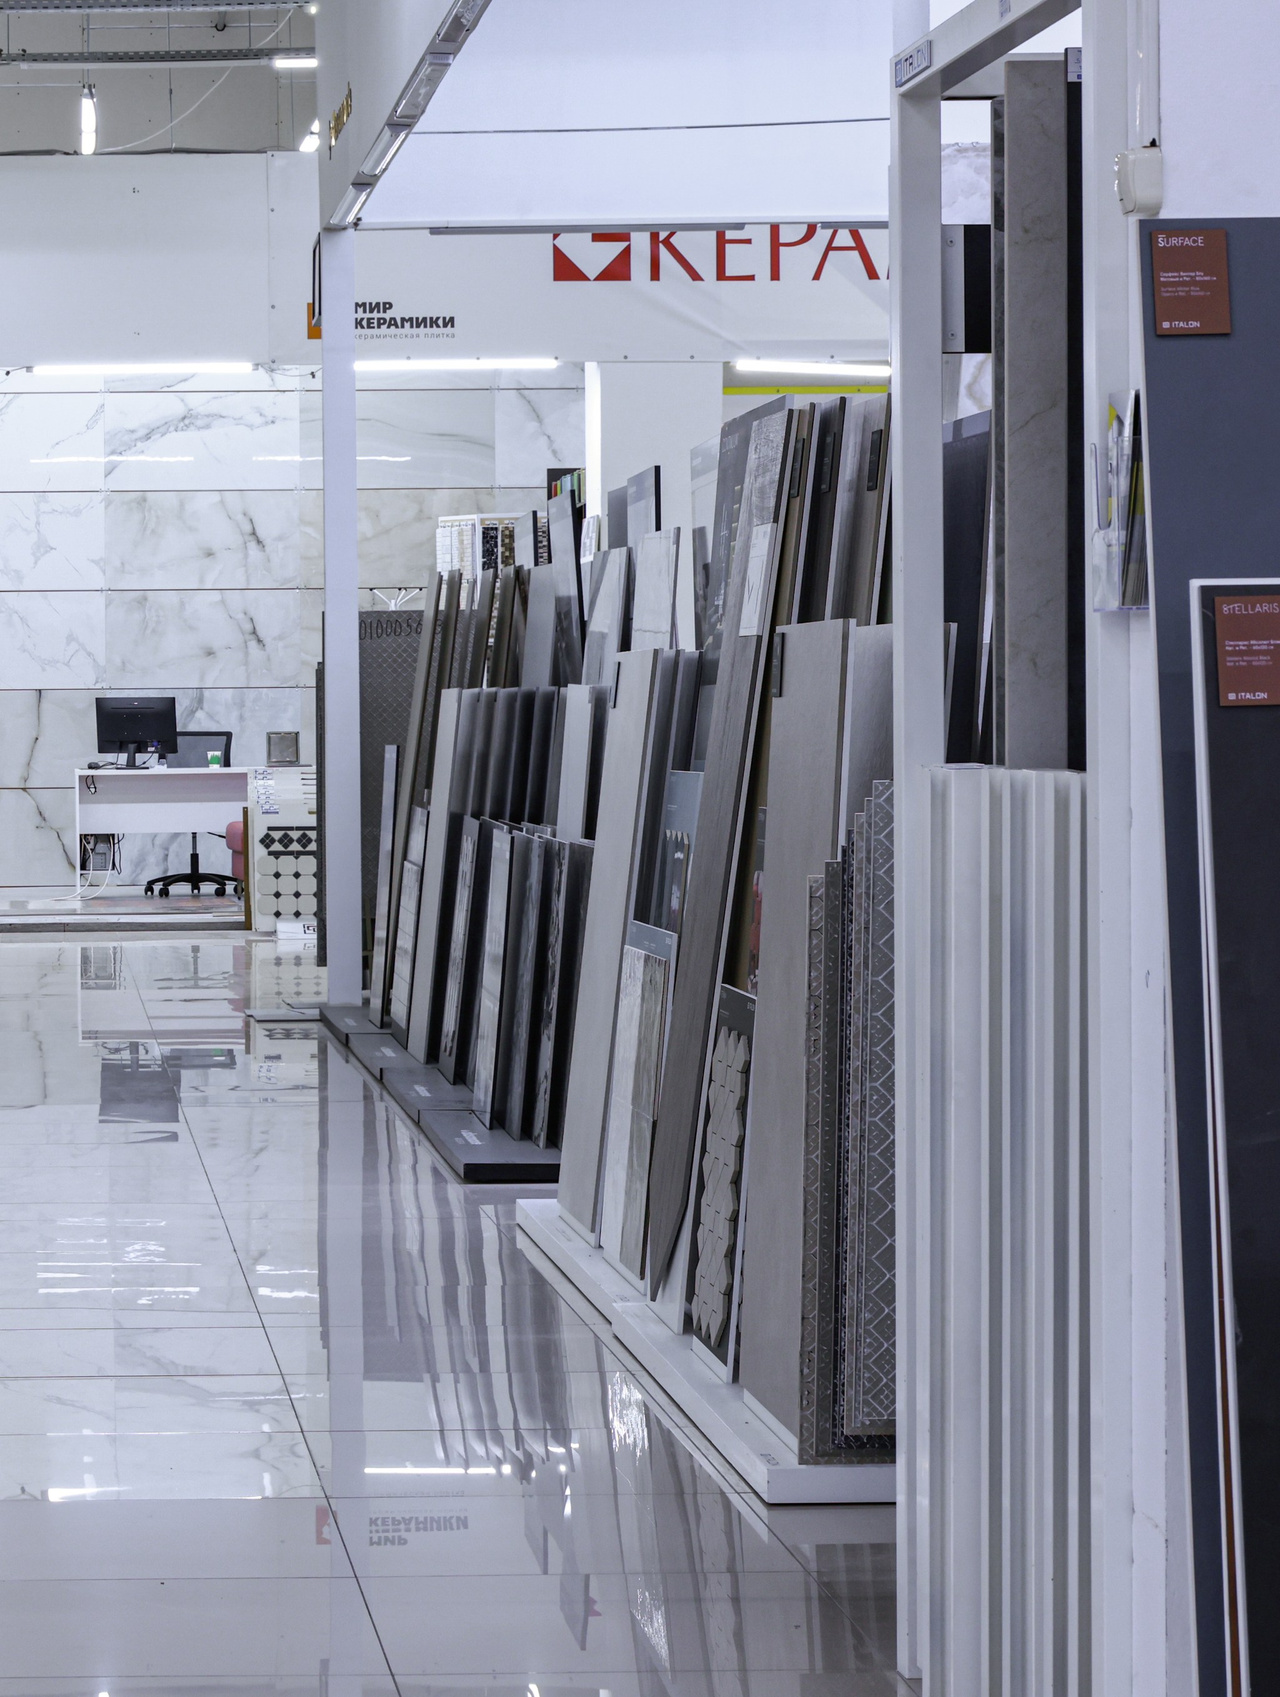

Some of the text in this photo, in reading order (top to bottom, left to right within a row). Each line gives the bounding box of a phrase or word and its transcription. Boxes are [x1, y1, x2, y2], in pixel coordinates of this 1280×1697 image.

[903, 45, 927, 78] ITALON
[1158, 235, 1205, 247] SURFACE
[355, 302, 393, 314] МИР
[355, 316, 455, 329] КЕРАМИКИ
[424, 332, 456, 340] плитка
[1222, 603, 1280, 614] STELLARIS
[1238, 692, 1268, 700] ITALON
